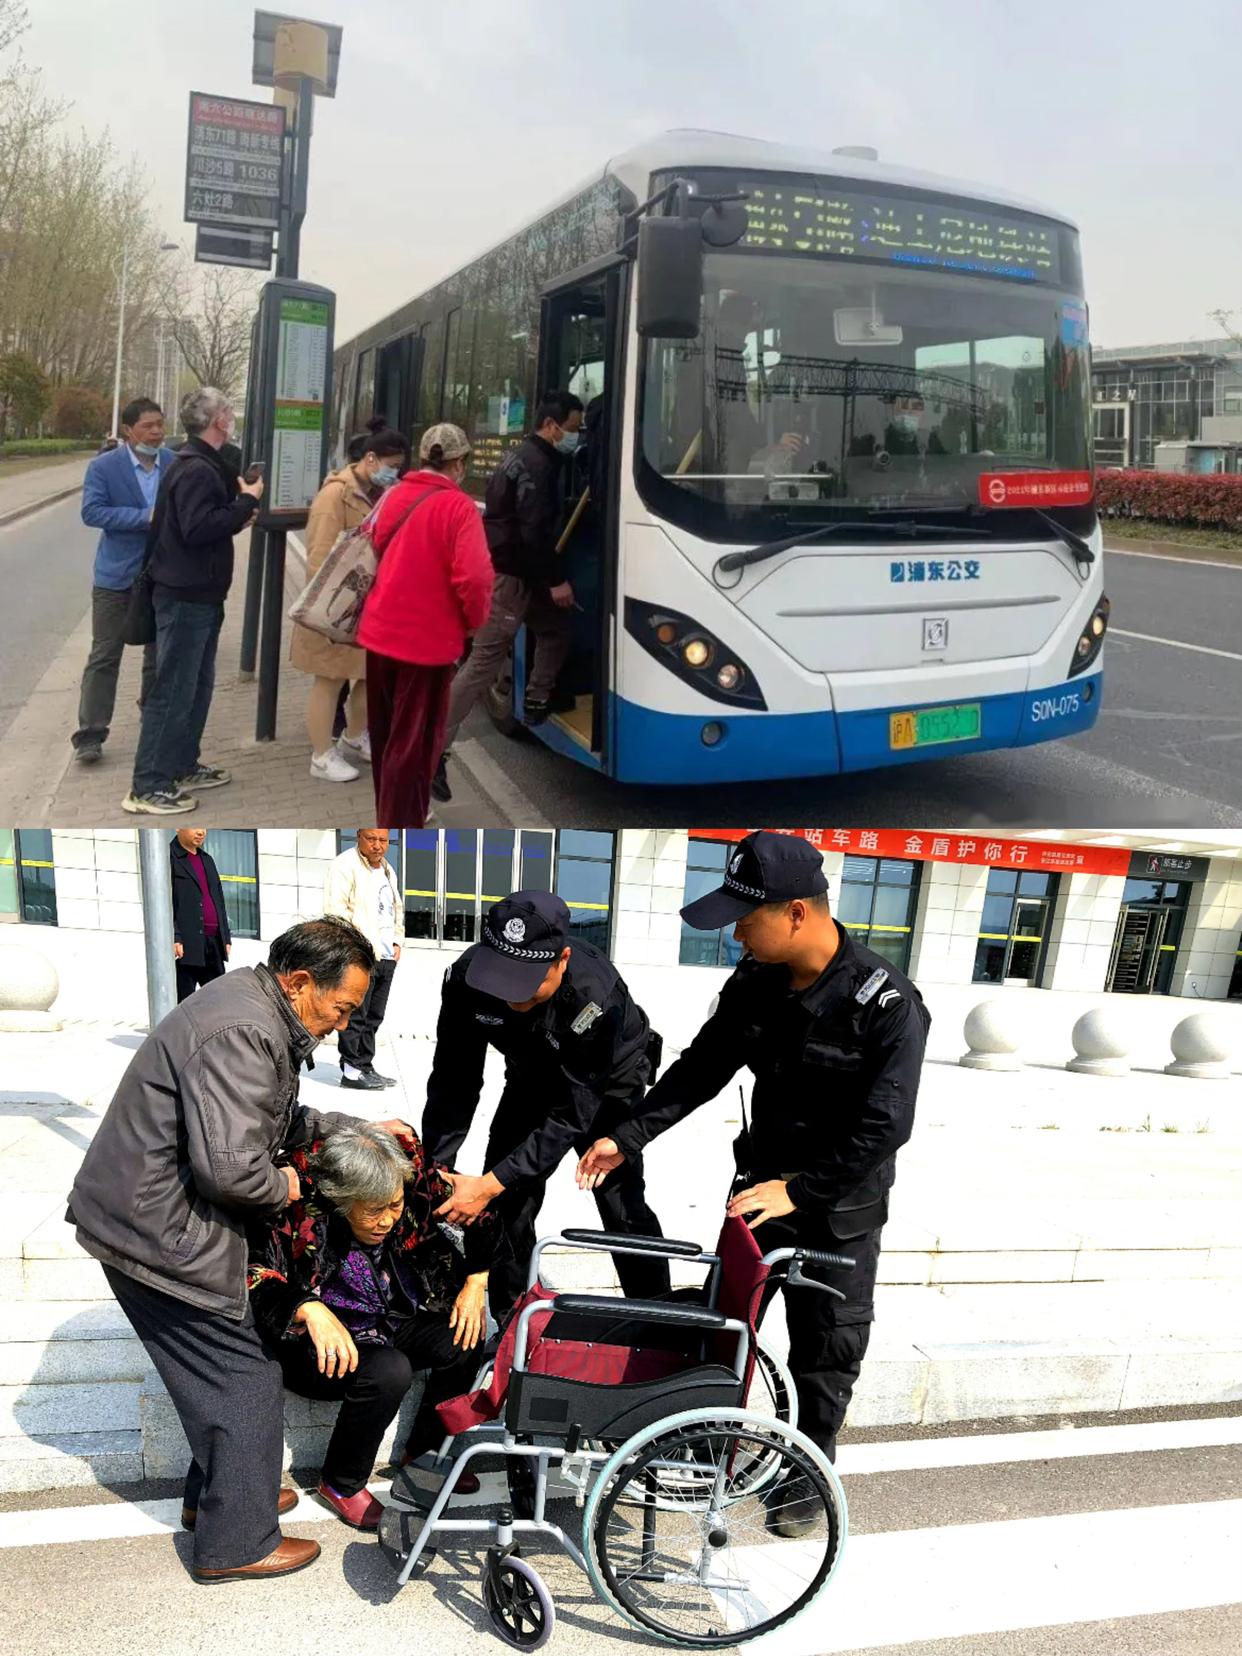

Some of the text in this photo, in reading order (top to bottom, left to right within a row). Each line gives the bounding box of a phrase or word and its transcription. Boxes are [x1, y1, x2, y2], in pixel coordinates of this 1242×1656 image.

[240, 165, 278, 181] 1036
[908, 560, 980, 581] 浦东公交
[904, 835, 1029, 863] 金盾护你行
